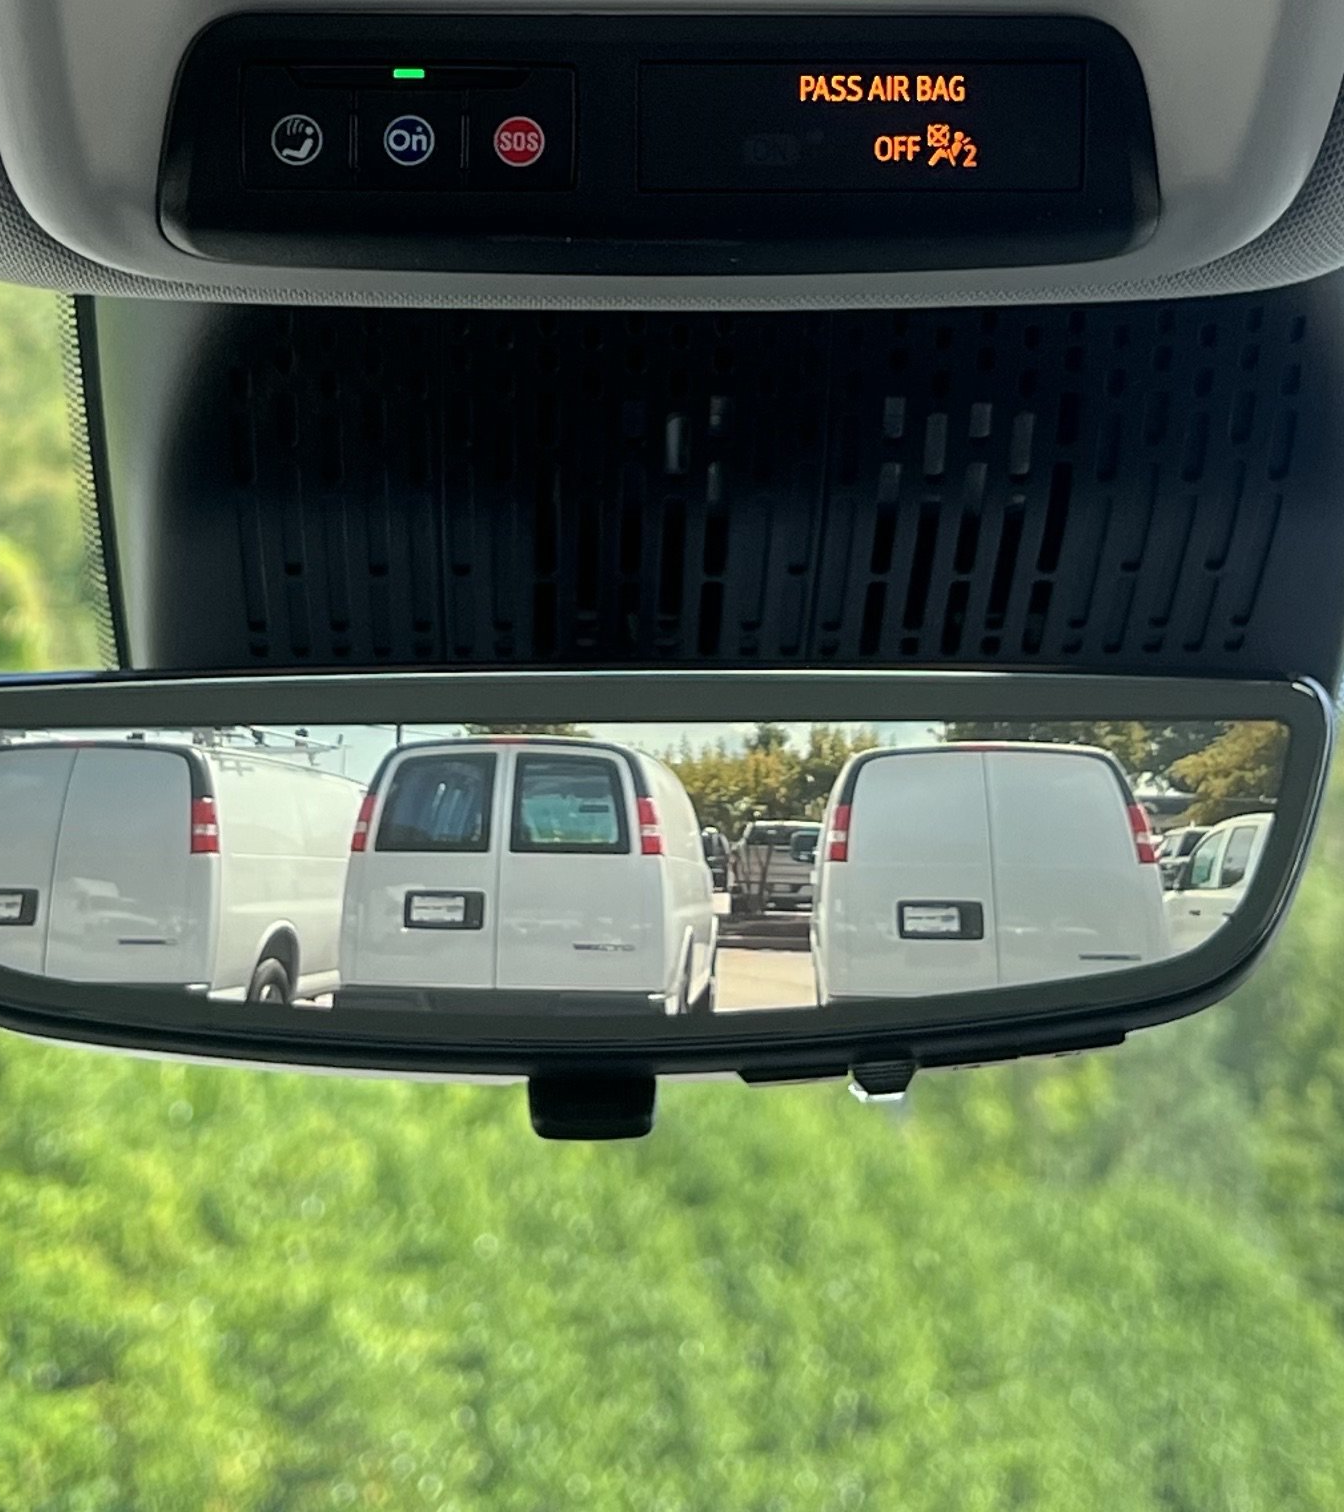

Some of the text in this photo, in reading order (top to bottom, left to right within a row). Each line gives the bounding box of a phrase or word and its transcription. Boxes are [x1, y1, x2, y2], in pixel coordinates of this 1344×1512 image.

[799, 74, 966, 103] PASS AIR BAG
[388, 126, 428, 152] On
[498, 130, 540, 152] SOS
[874, 135, 922, 162] OFF
